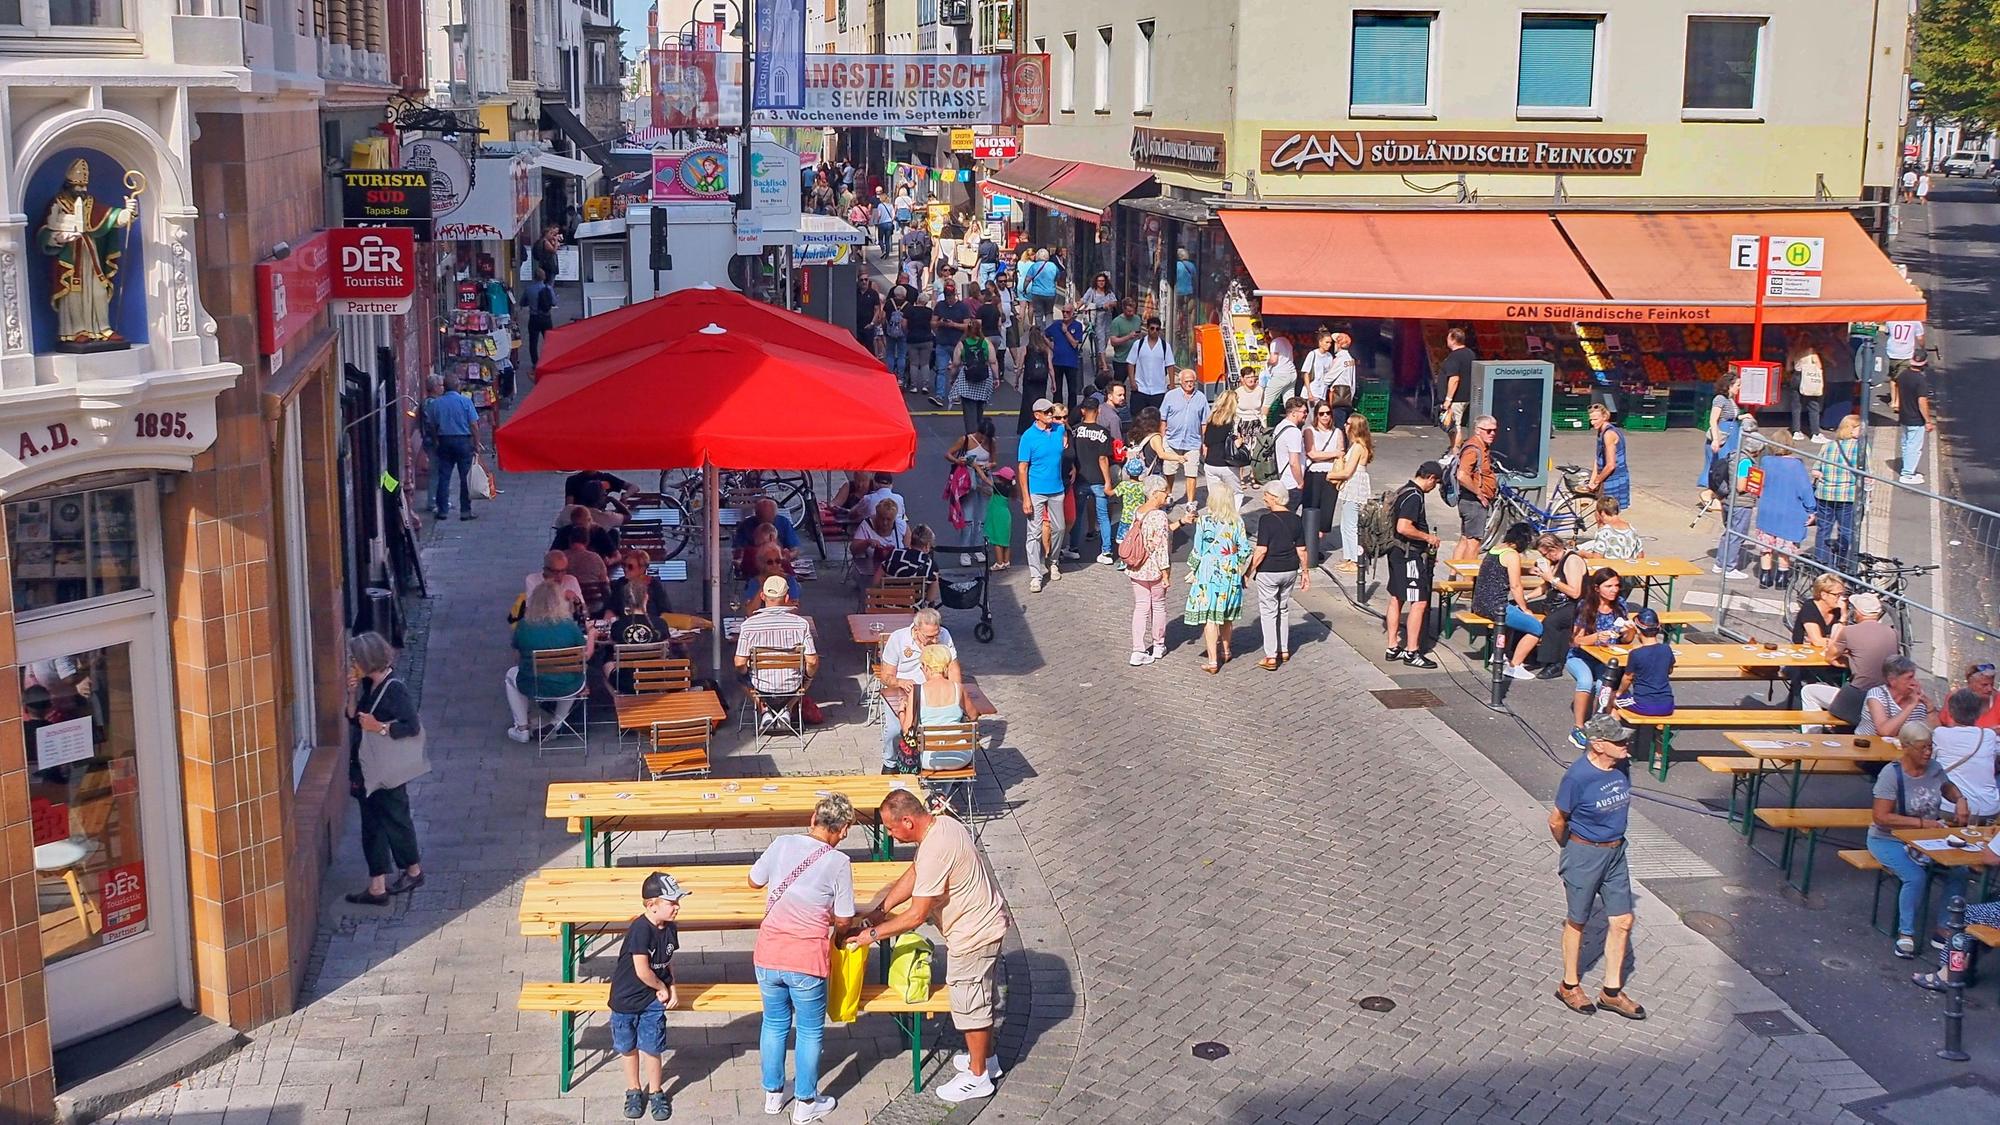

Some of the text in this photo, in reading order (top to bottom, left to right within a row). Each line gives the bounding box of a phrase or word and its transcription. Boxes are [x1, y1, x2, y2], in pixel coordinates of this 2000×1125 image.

[904, 63, 986, 89] DESCH
[831, 89, 987, 108] SEVERINSTRASSE
[769, 109, 784, 121] 3.
[786, 110, 879, 122] Wochenende
[883, 110, 901, 121] im
[904, 109, 981, 122] September
[975, 137, 1015, 148] KIOSK
[988, 147, 1004, 157] 46
[1270, 131, 1637, 171] CAN SÜDLÄNDISCHE FEINKOST
[345, 174, 427, 187] TURISTA
[366, 188, 406, 203] SÜD
[364, 206, 409, 217] Tapas-Bar
[802, 234, 858, 243] Backfisch
[342, 245, 403, 272] DER
[1793, 247, 1805, 262] H
[344, 276, 404, 287] Touristik
[347, 301, 398, 313] Partner
[1506, 306, 1710, 320] CAN Südländische Feinkost
[1894, 324, 1911, 341] 07
[1495, 368, 1543, 376] Chlodwigplatz
[18, 412, 193, 460] A.D. 1895.
[105, 875, 140, 900] DER
[109, 927, 137, 940] Partner
